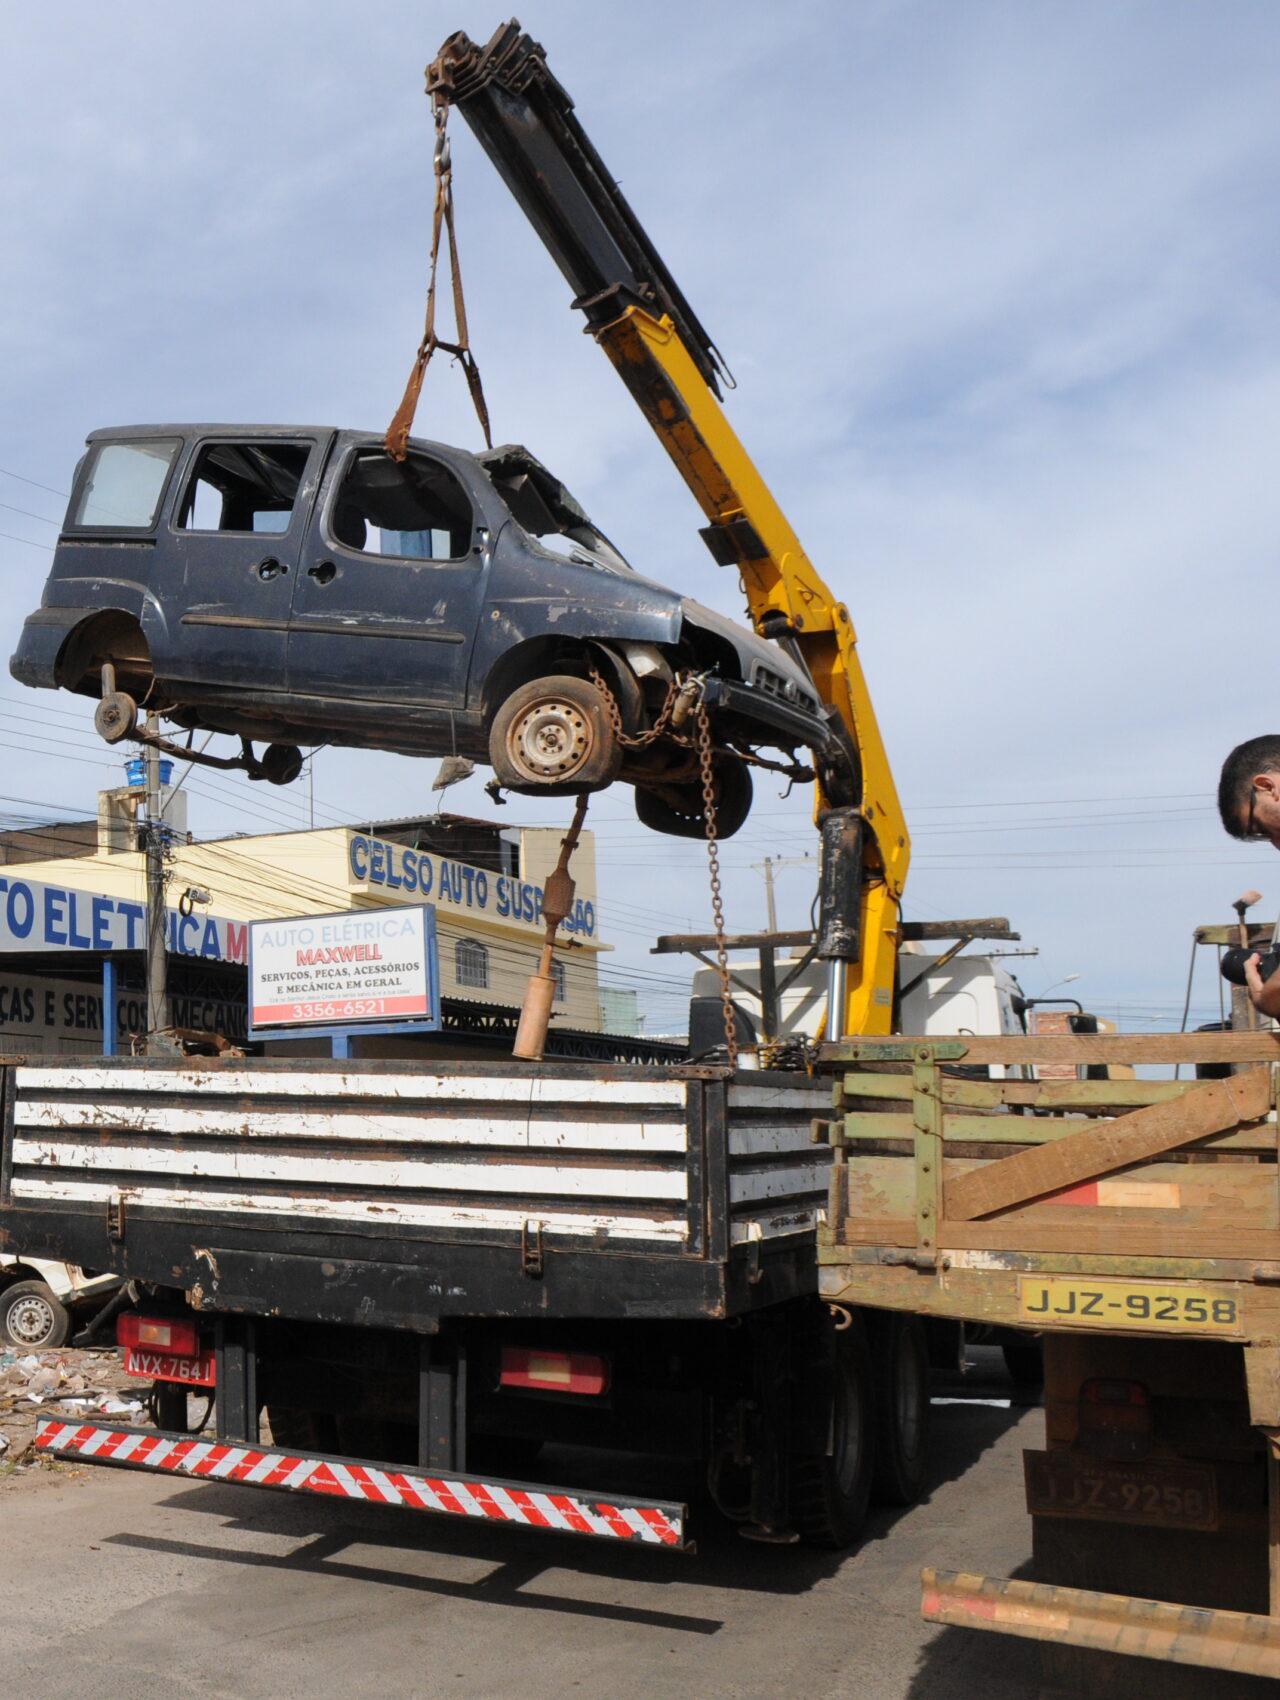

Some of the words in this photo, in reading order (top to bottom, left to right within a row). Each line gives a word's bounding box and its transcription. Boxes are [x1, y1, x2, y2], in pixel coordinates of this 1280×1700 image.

[350, 835, 433, 895] CELSO
[438, 860, 487, 908] AUTO
[44, 887, 221, 959] ELÉTICA
[260, 927, 314, 948] AUTO
[322, 918, 416, 943] ELÉTRICA
[296, 943, 383, 966] MAXWELL
[260, 969, 312, 982] SERVIÇOS,
[315, 967, 351, 978] PEÇAS,
[353, 962, 420, 975] ACESSÓRIOS
[277, 985, 283, 994] E
[285, 981, 343, 993] MECÂNICA
[346, 980, 361, 989] EM
[365, 977, 402, 987] GERAL
[44, 990, 55, 1026] E
[292, 999, 386, 1019] 3356-6521
[1026, 1289, 1237, 1324] JJZ-9258
